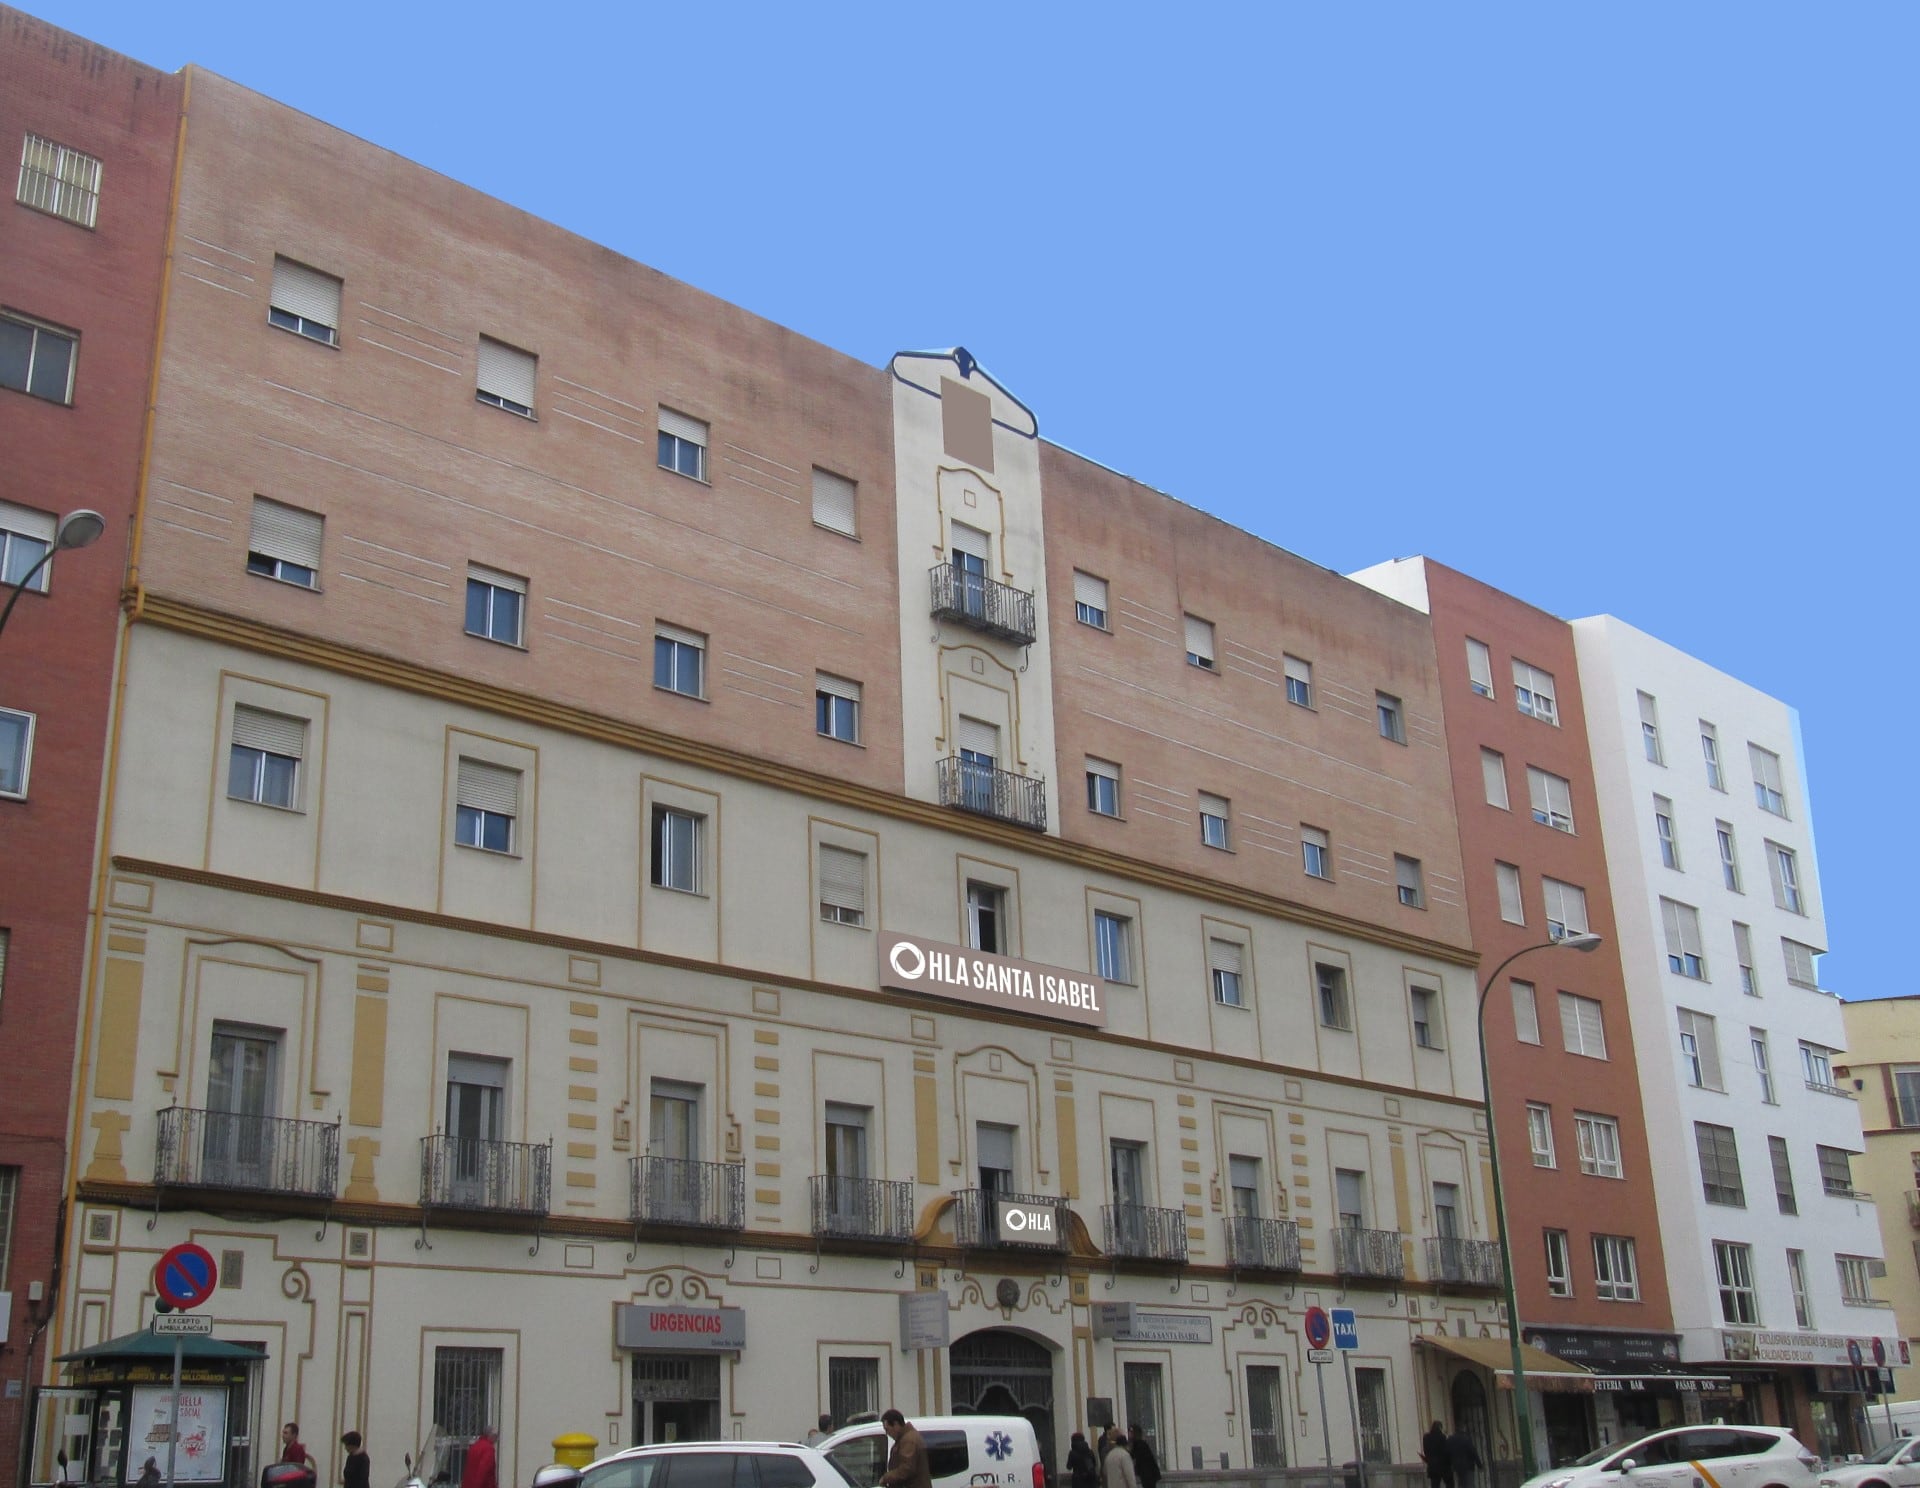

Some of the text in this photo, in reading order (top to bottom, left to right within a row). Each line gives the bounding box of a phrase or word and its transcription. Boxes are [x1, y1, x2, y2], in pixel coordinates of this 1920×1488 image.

[929, 950, 1100, 1012] HLA SANTA ISABEL
[1028, 1212, 1051, 1231] HLA
[650, 1312, 722, 1333] URGENCIAS
[1334, 1322, 1356, 1336] TAXI
[1594, 1380, 1645, 1391] FETERIA BAR
[1701, 1380, 1715, 1391] DOS
[180, 1396, 202, 1407] UELLA
